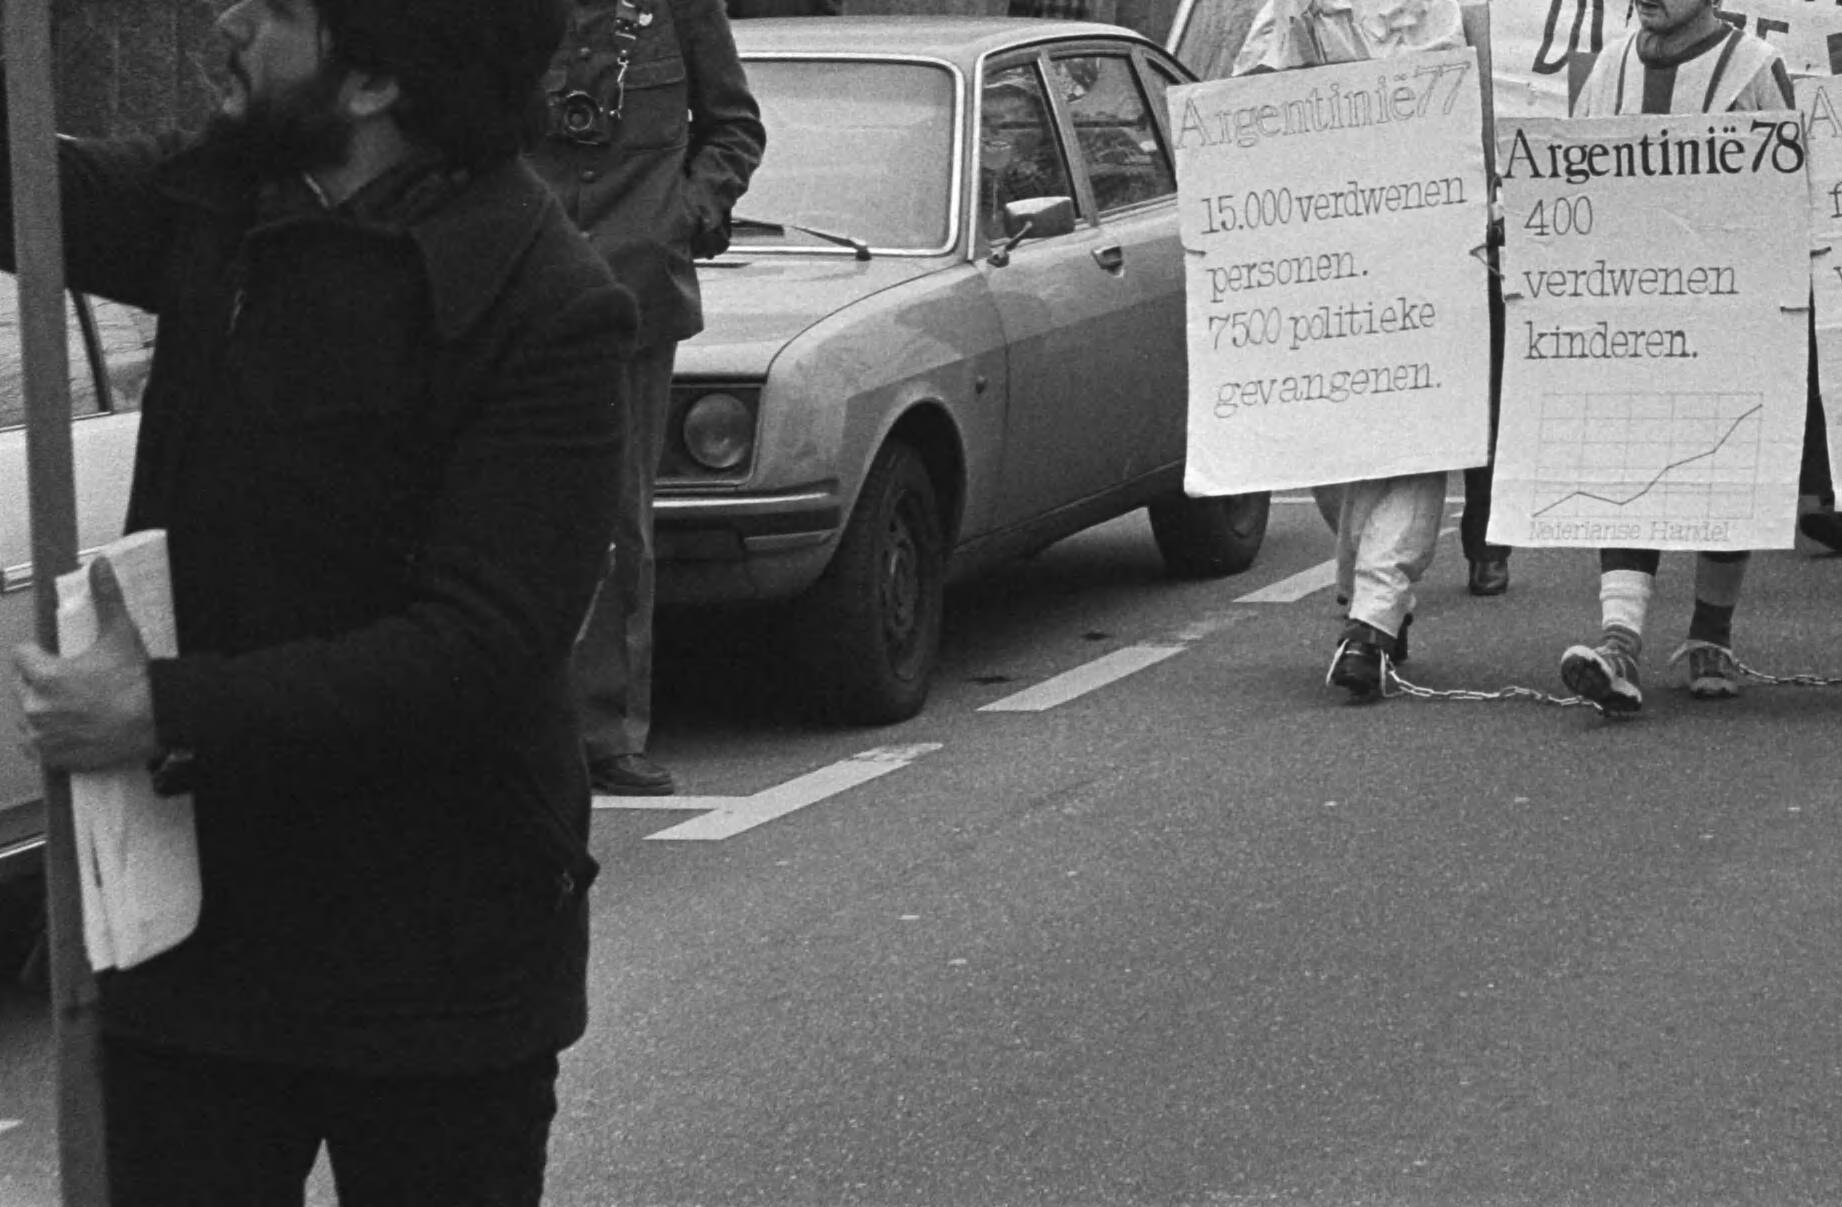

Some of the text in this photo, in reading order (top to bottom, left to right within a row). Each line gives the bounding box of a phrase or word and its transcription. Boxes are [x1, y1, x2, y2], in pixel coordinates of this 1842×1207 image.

[1200, 174, 1467, 234] 15.000 verdwenen
[1524, 196, 1593, 236] 400
[1206, 249, 1367, 302] personen.
[1522, 260, 1739, 298] verdwenen
[1208, 295, 1435, 351] 7500 politieke
[1524, 321, 1698, 361] kinderen.
[1213, 357, 1442, 418] gevangenen.
